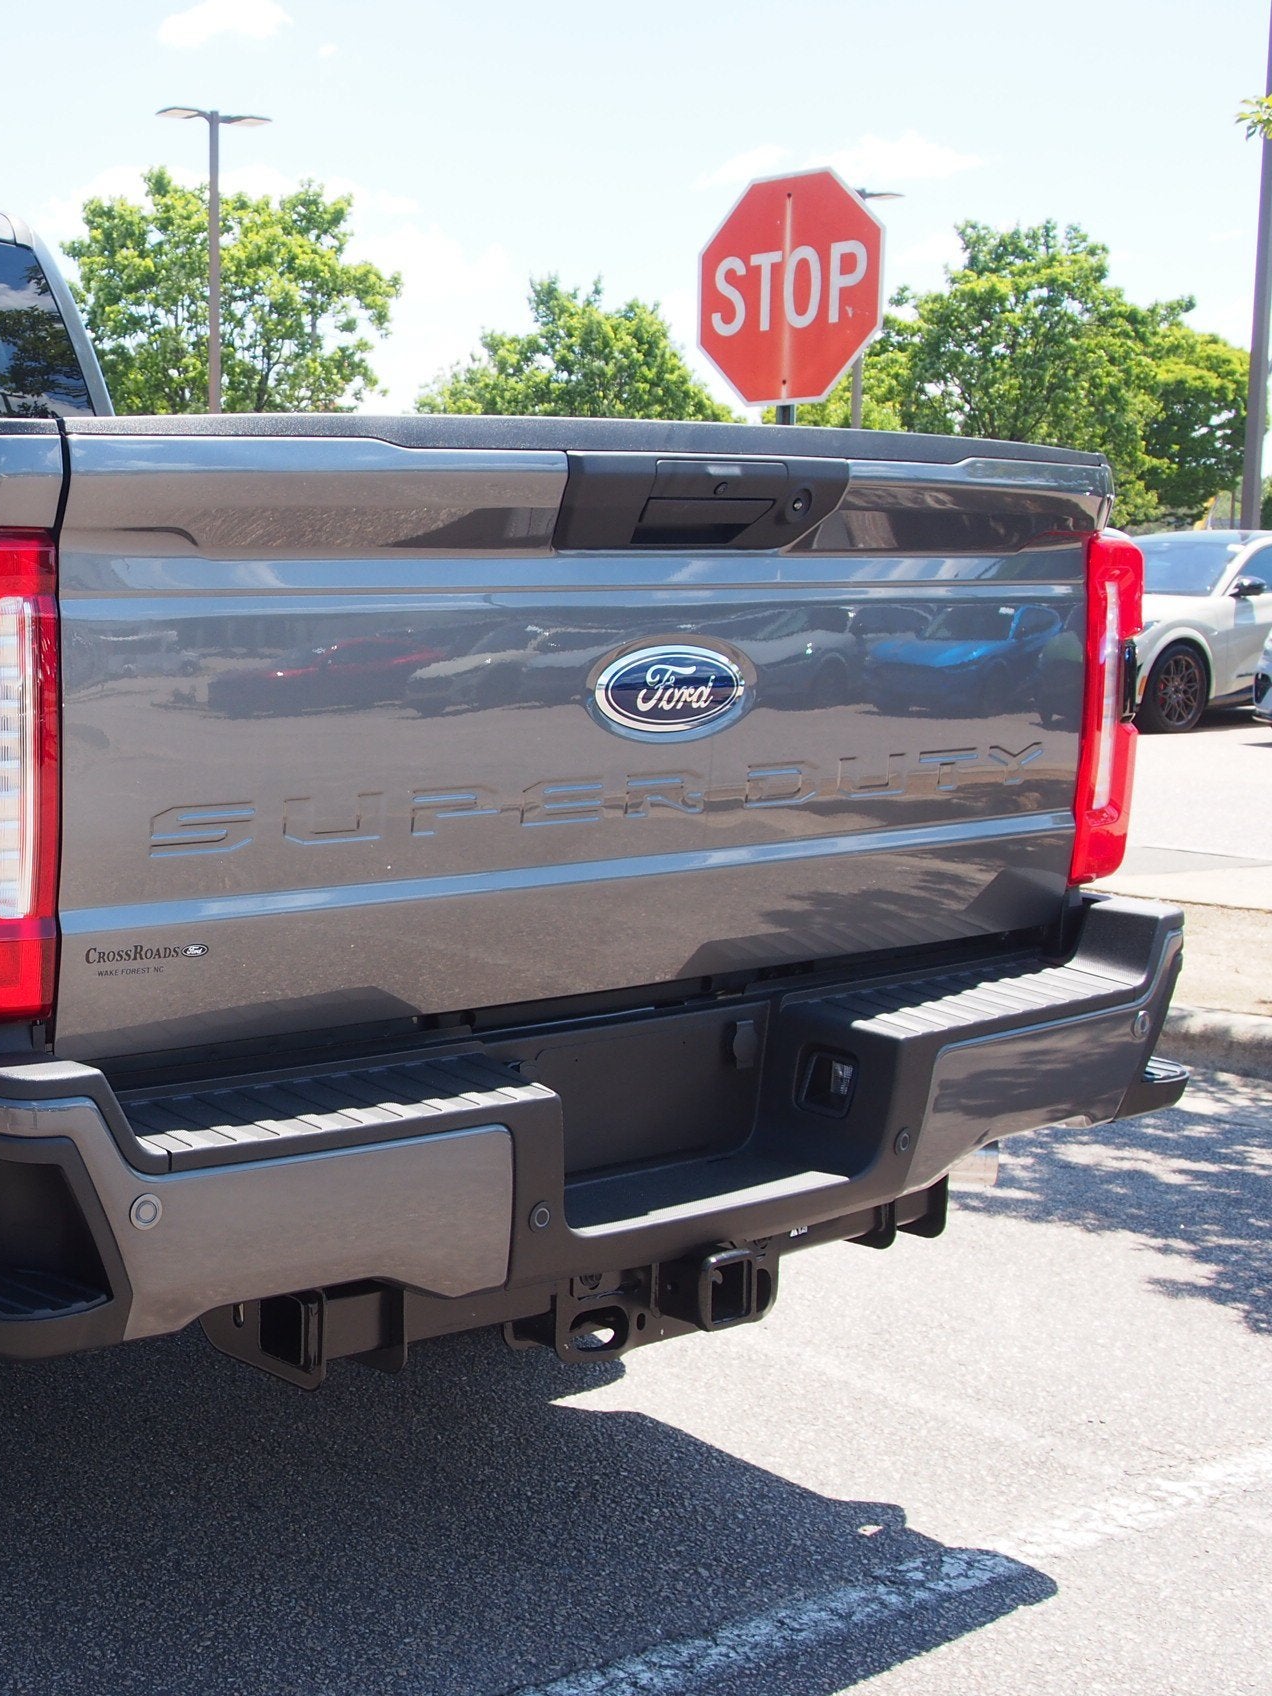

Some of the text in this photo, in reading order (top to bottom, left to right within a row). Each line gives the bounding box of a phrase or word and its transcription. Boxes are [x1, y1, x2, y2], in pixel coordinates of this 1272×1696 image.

[711, 239, 868, 336] STOP
[636, 663, 715, 712] Ford
[150, 741, 1044, 858] SUPER DUTY
[97, 969, 119, 977] WAKE
[121, 967, 150, 976] FOREST
